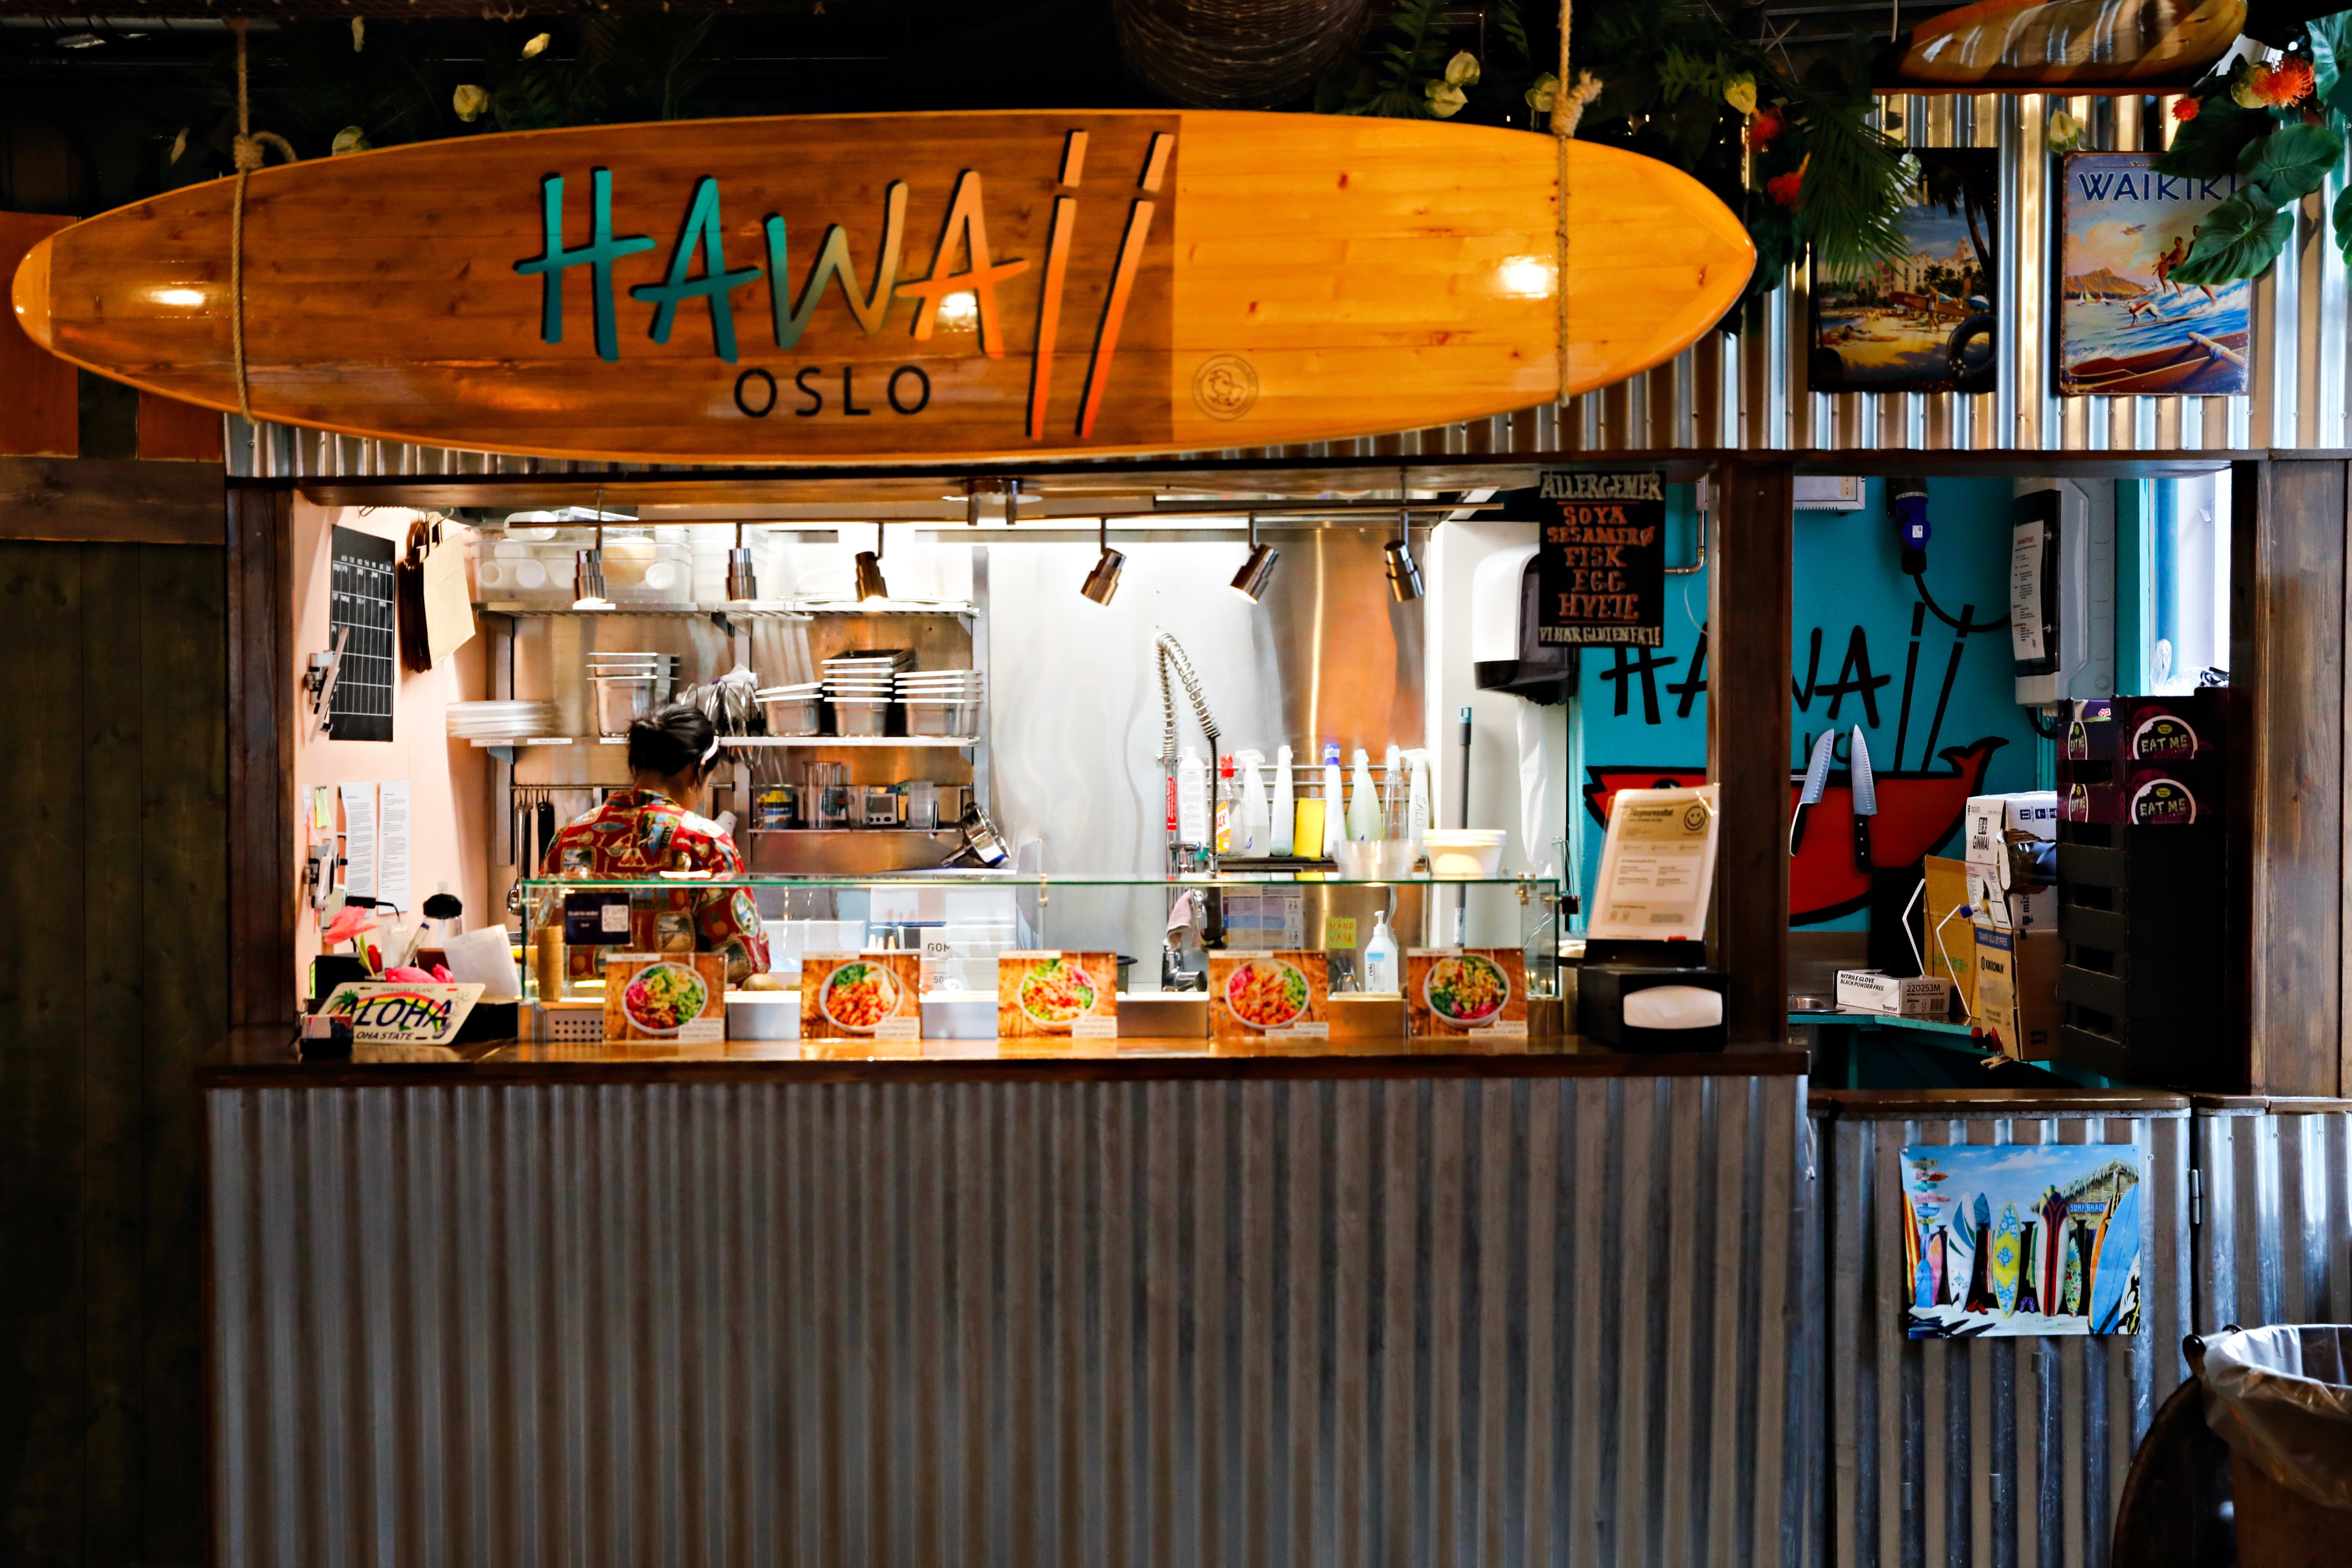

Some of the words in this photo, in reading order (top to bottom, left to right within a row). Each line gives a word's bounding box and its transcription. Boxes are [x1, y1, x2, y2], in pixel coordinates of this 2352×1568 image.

[2078, 172, 2235, 201] WAIKIKI
[513, 129, 1174, 439] HAWAII
[734, 366, 931, 418] OSLO
[1539, 473, 1664, 500] ALLERGENER
[1563, 506, 1628, 525] SOYA
[1564, 546, 1626, 567] FISK
[1572, 569, 1626, 592] EGG
[1559, 593, 1639, 619] HVETE
[1539, 626, 1552, 642] VI
[1554, 627, 1582, 642] HAR
[2141, 738, 2166, 753] EAT
[2169, 734, 2188, 749] ME
[2140, 801, 2164, 817] EAT
[2168, 798, 2186, 813] ME
[1217, 812, 1226, 830] AX
[1973, 835, 1989, 851] GINMAI
[1330, 933, 1353, 945] VASK
[1999, 936, 2008, 946] FREE
[1841, 973, 1859, 981] NITRILE
[1854, 981, 1873, 989] POWDER
[1907, 984, 1941, 992] 220253M
[339, 997, 452, 1027] ALOHA
[381, 1032, 413, 1040] STATE
